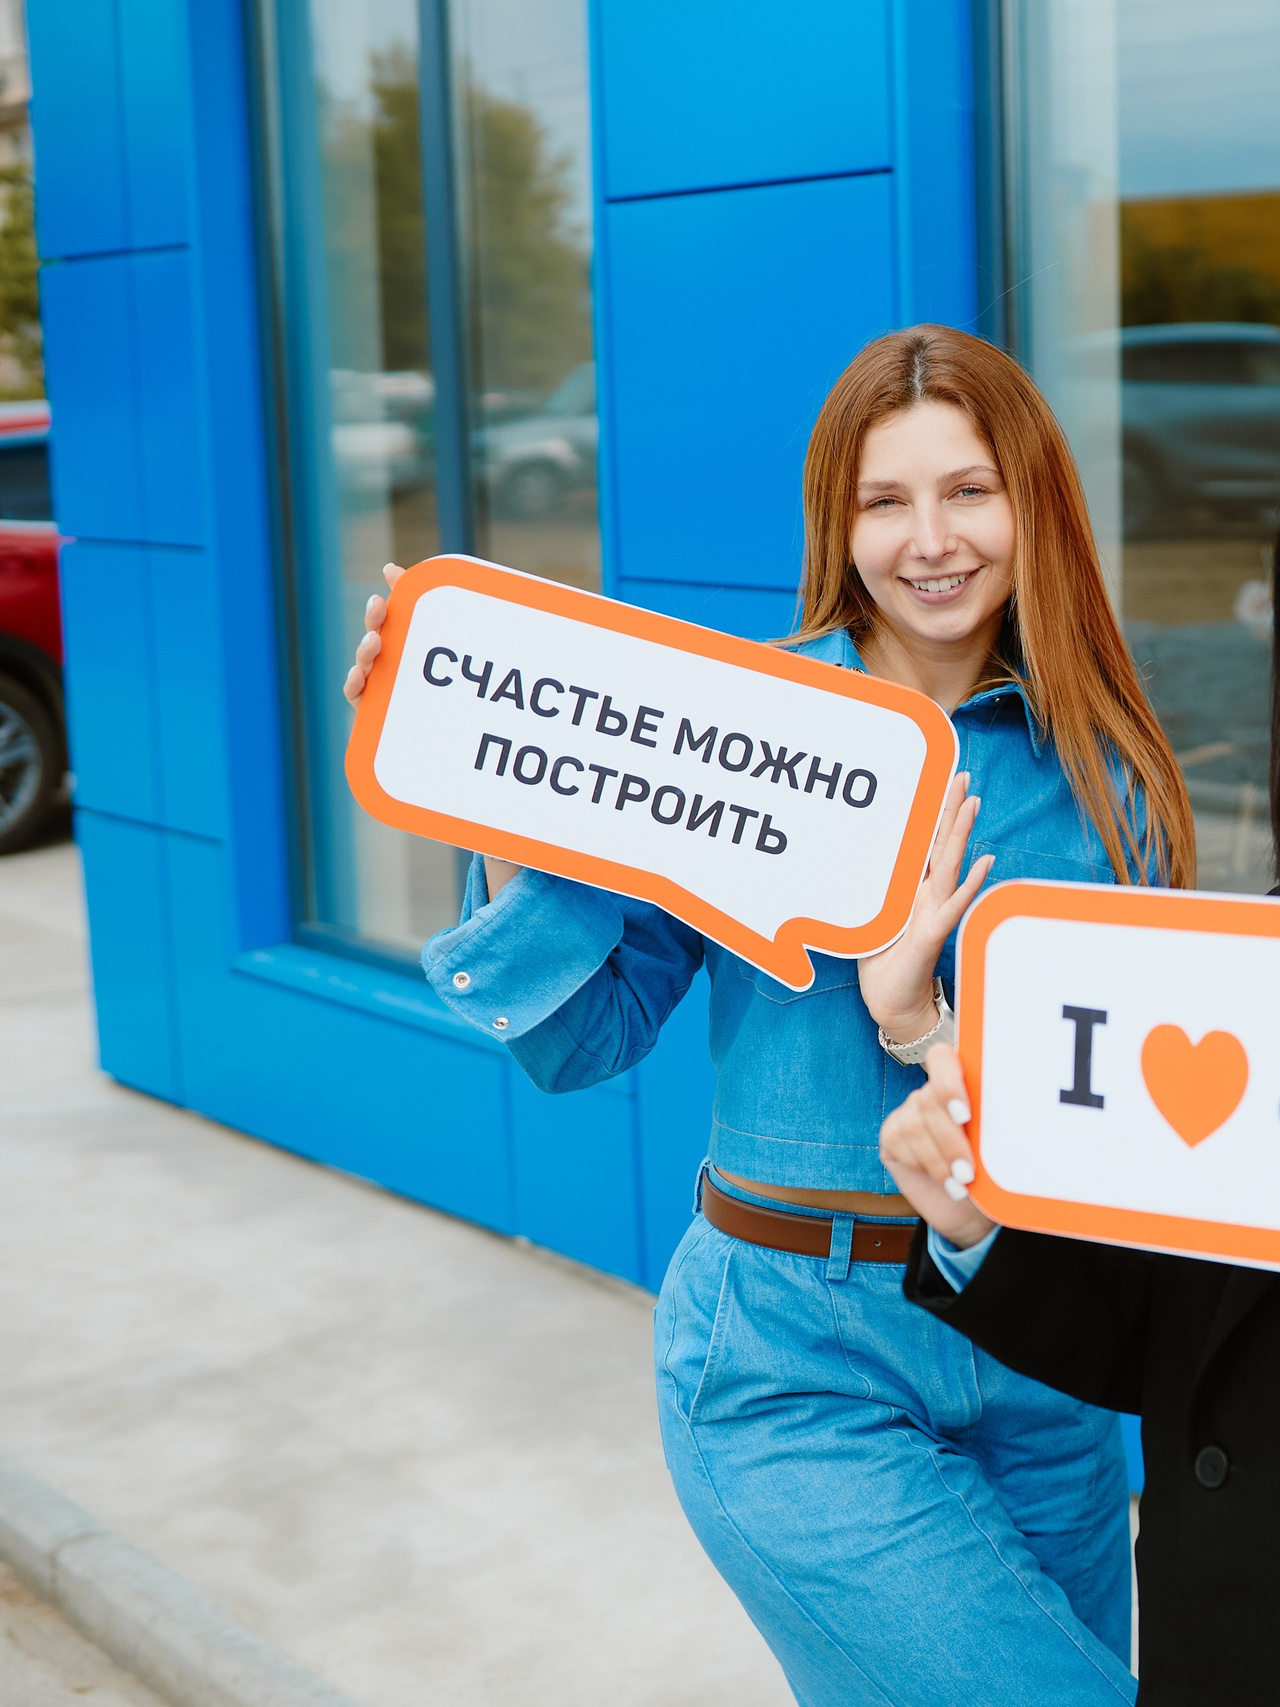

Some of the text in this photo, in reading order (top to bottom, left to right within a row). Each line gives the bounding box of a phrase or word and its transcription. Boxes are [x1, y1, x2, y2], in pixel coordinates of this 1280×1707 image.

[422, 646, 879, 810] СЧАСТЬЕ МОЖНО
[473, 732, 789, 856] ПОСТРОИТЬ
[1059, 1004, 1109, 1110] I
